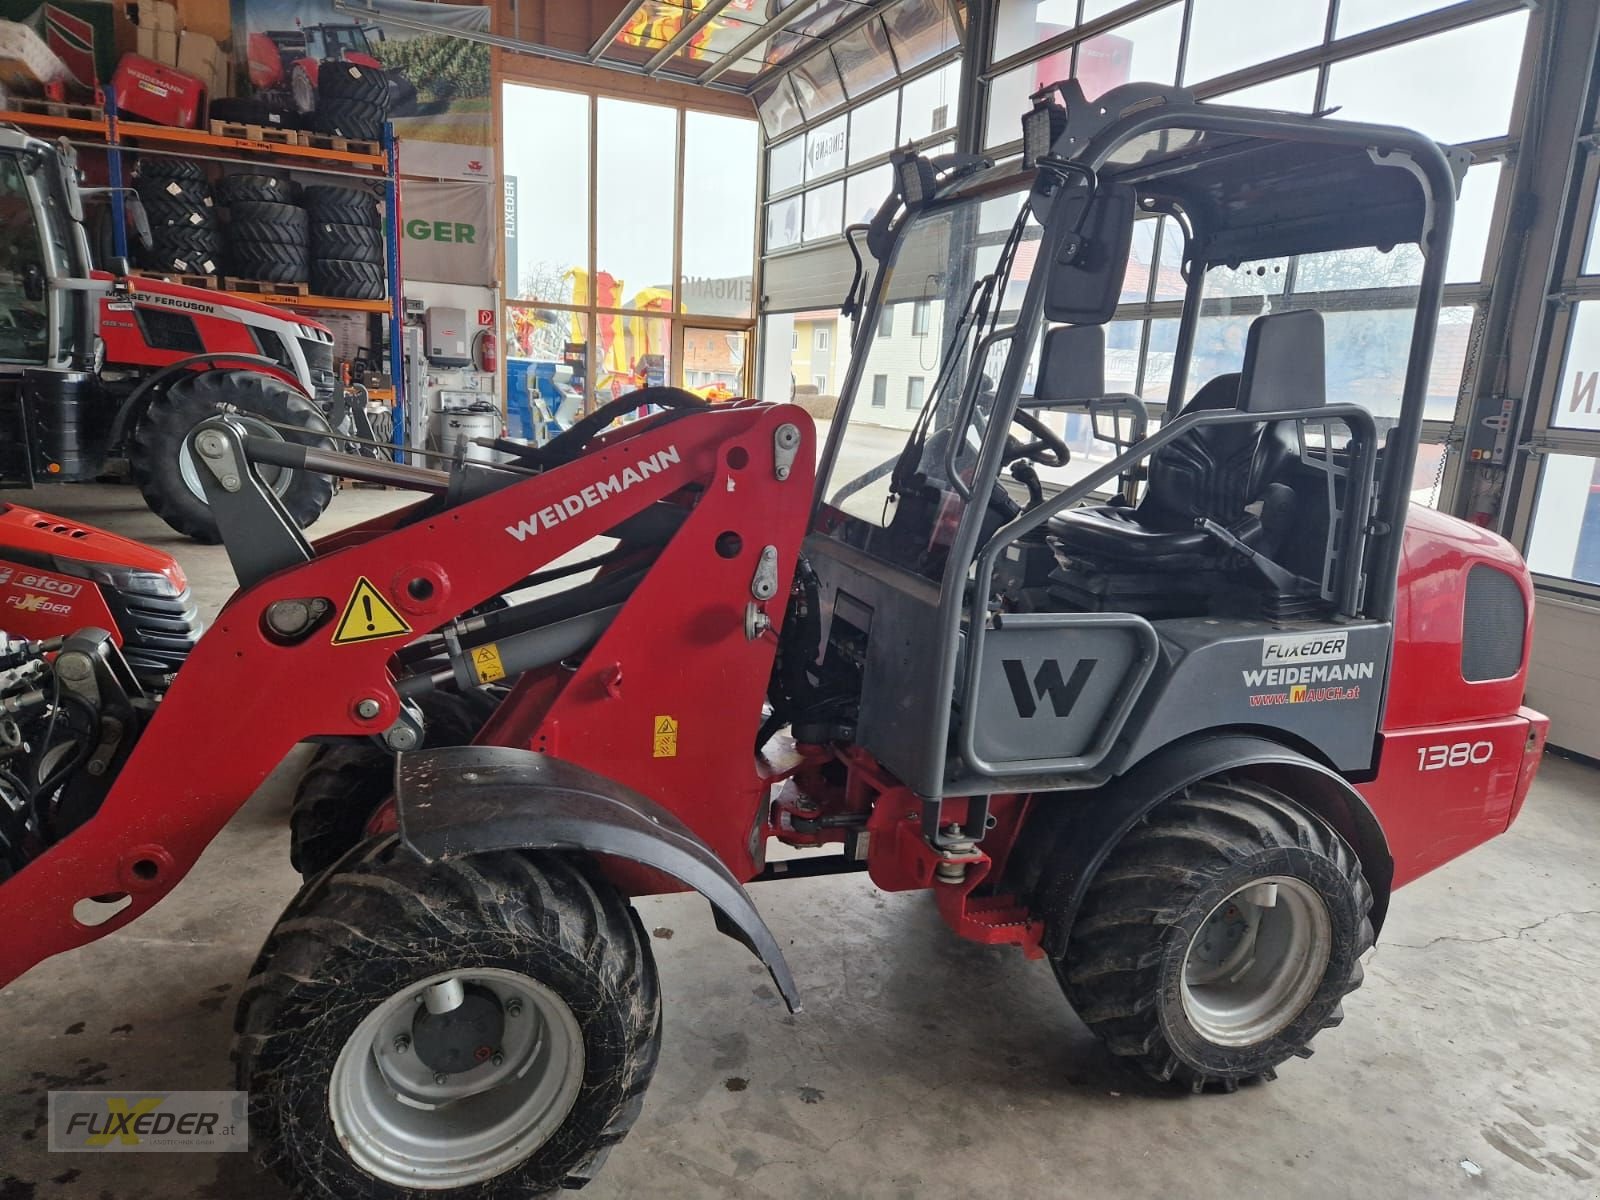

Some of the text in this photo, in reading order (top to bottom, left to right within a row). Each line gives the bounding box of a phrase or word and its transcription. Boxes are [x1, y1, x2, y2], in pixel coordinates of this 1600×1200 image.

[505, 181, 515, 238] FLIXEDER
[155, 297, 214, 313] FERGUSON
[505, 445, 681, 542] WEIDEMANN
[22, 575, 73, 593] efco
[1265, 640, 1345, 659] FLIXEDER
[1242, 662, 1374, 687] WEIDEMANN
[1001, 659, 1099, 718] W
[1417, 741, 1493, 771] 1380
